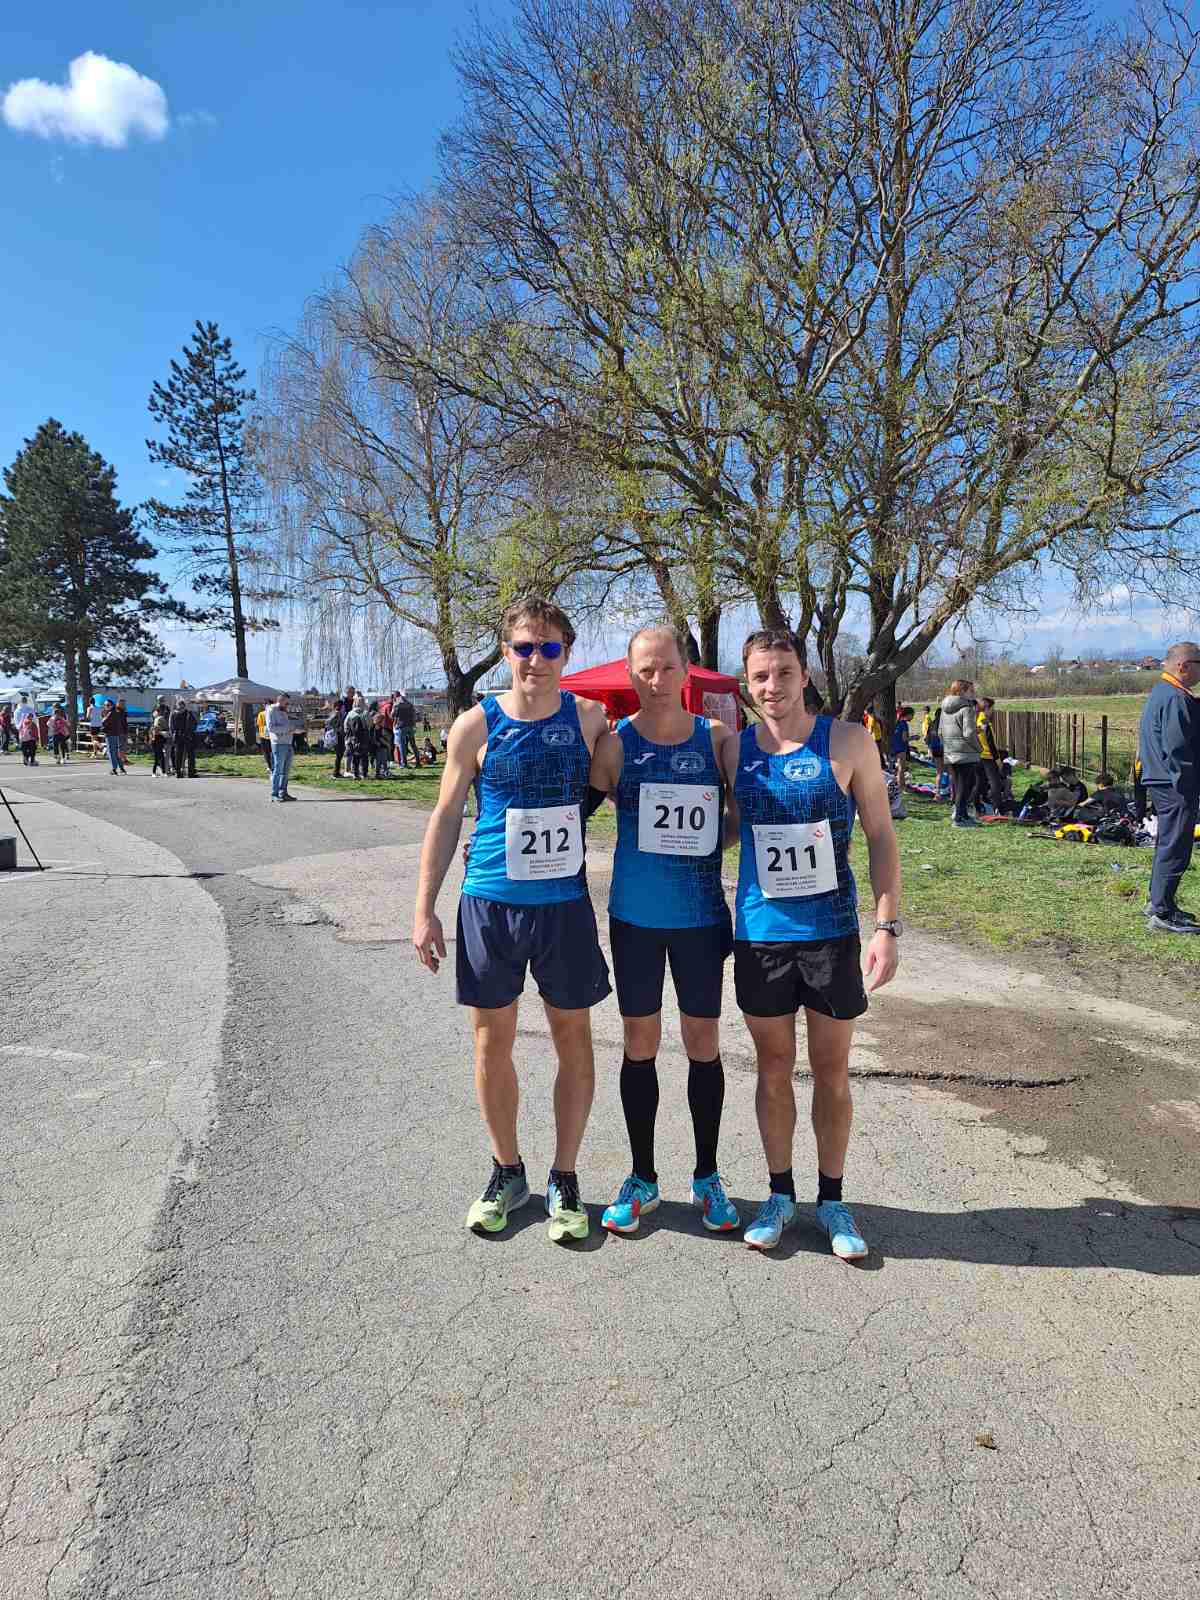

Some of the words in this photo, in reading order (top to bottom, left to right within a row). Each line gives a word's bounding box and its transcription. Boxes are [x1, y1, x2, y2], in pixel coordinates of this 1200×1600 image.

[654, 805, 705, 830] 210
[521, 828, 569, 854] 212
[766, 845, 816, 872] 211
